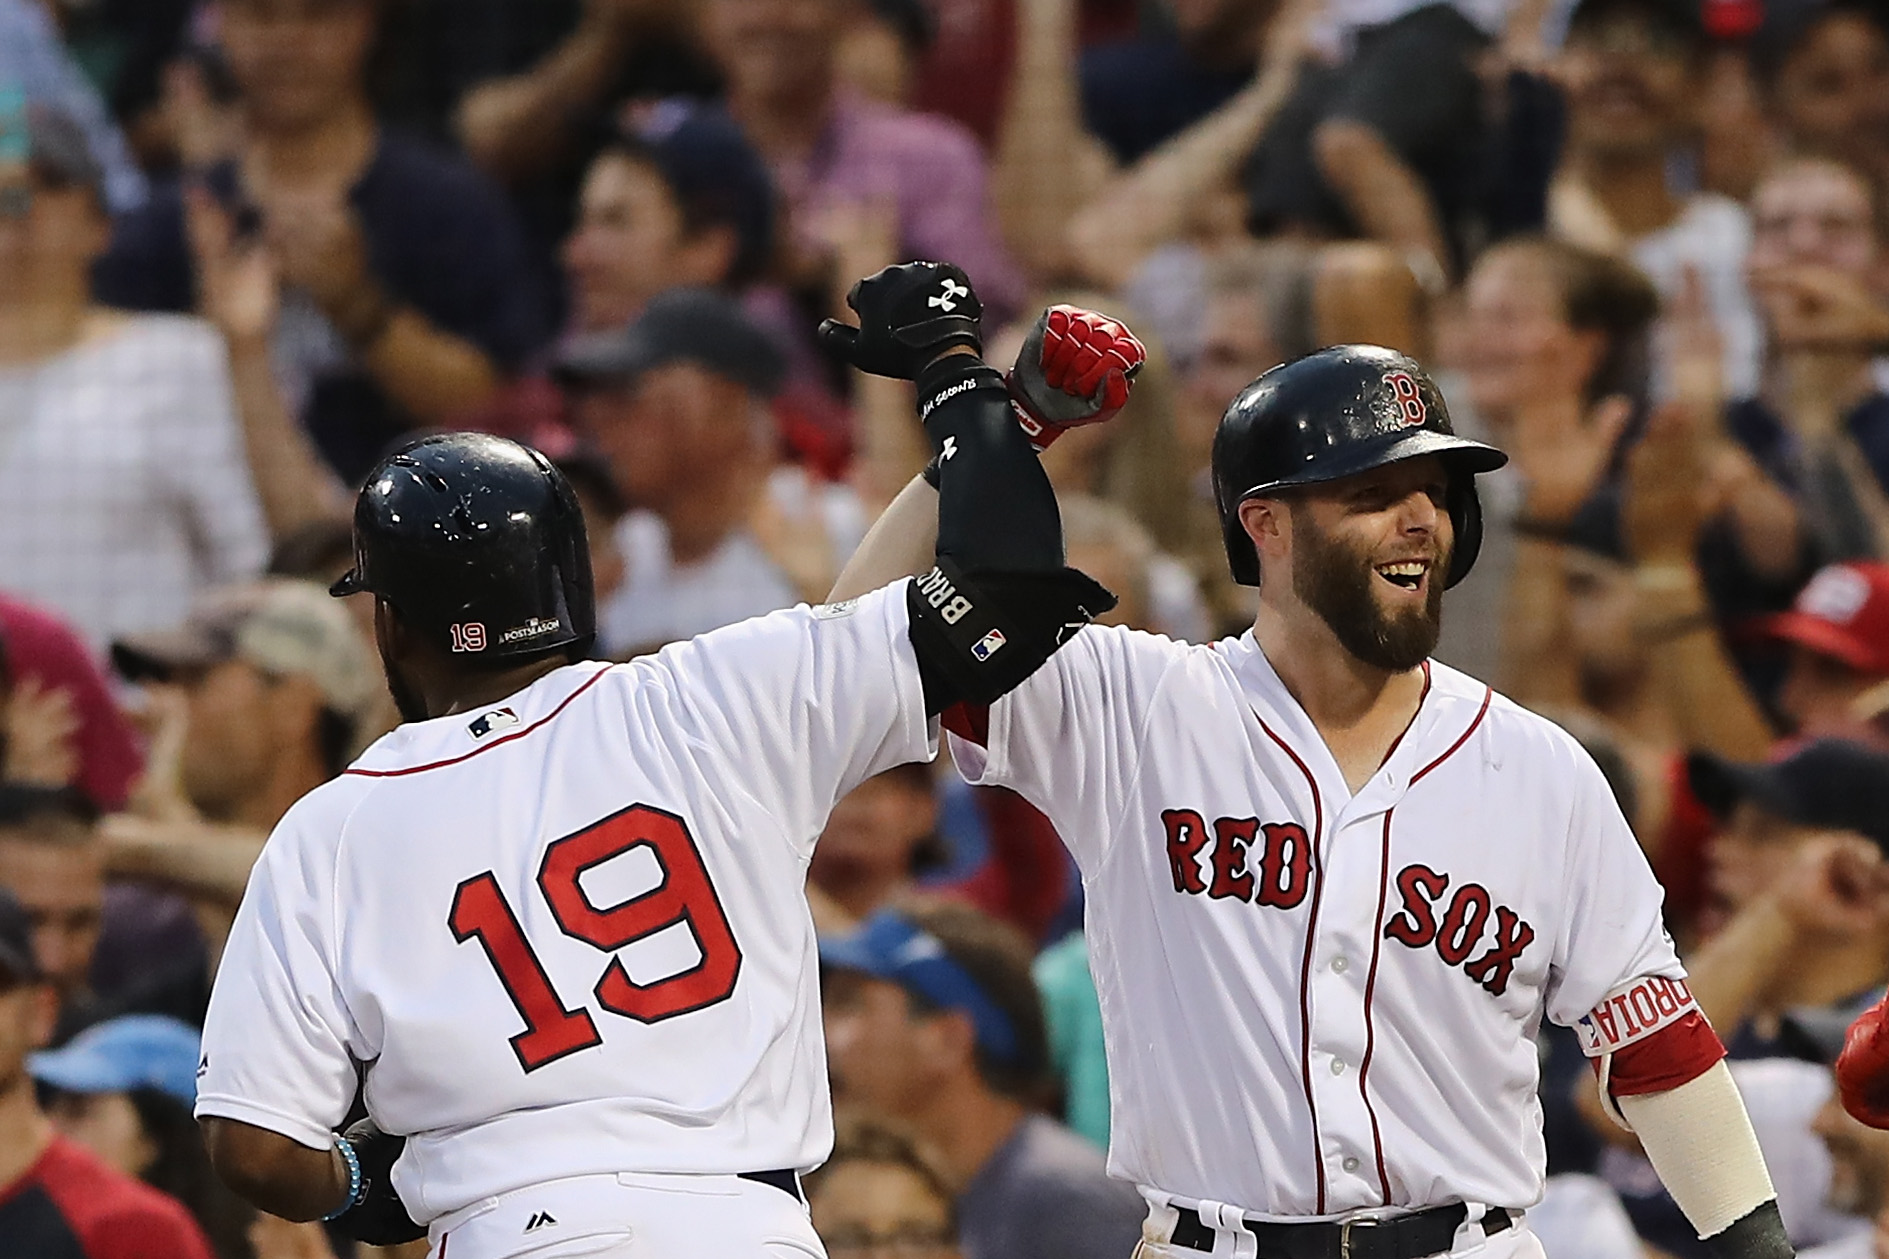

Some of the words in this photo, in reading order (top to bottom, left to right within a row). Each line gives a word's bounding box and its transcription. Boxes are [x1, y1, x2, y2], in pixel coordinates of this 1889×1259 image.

[1381, 371, 1427, 429] B
[450, 622, 487, 652] 19
[504, 619, 560, 641] POSTSEASON
[1161, 808, 1312, 910] RED
[1384, 863, 1535, 997] SOX
[448, 802, 743, 1075] 19
